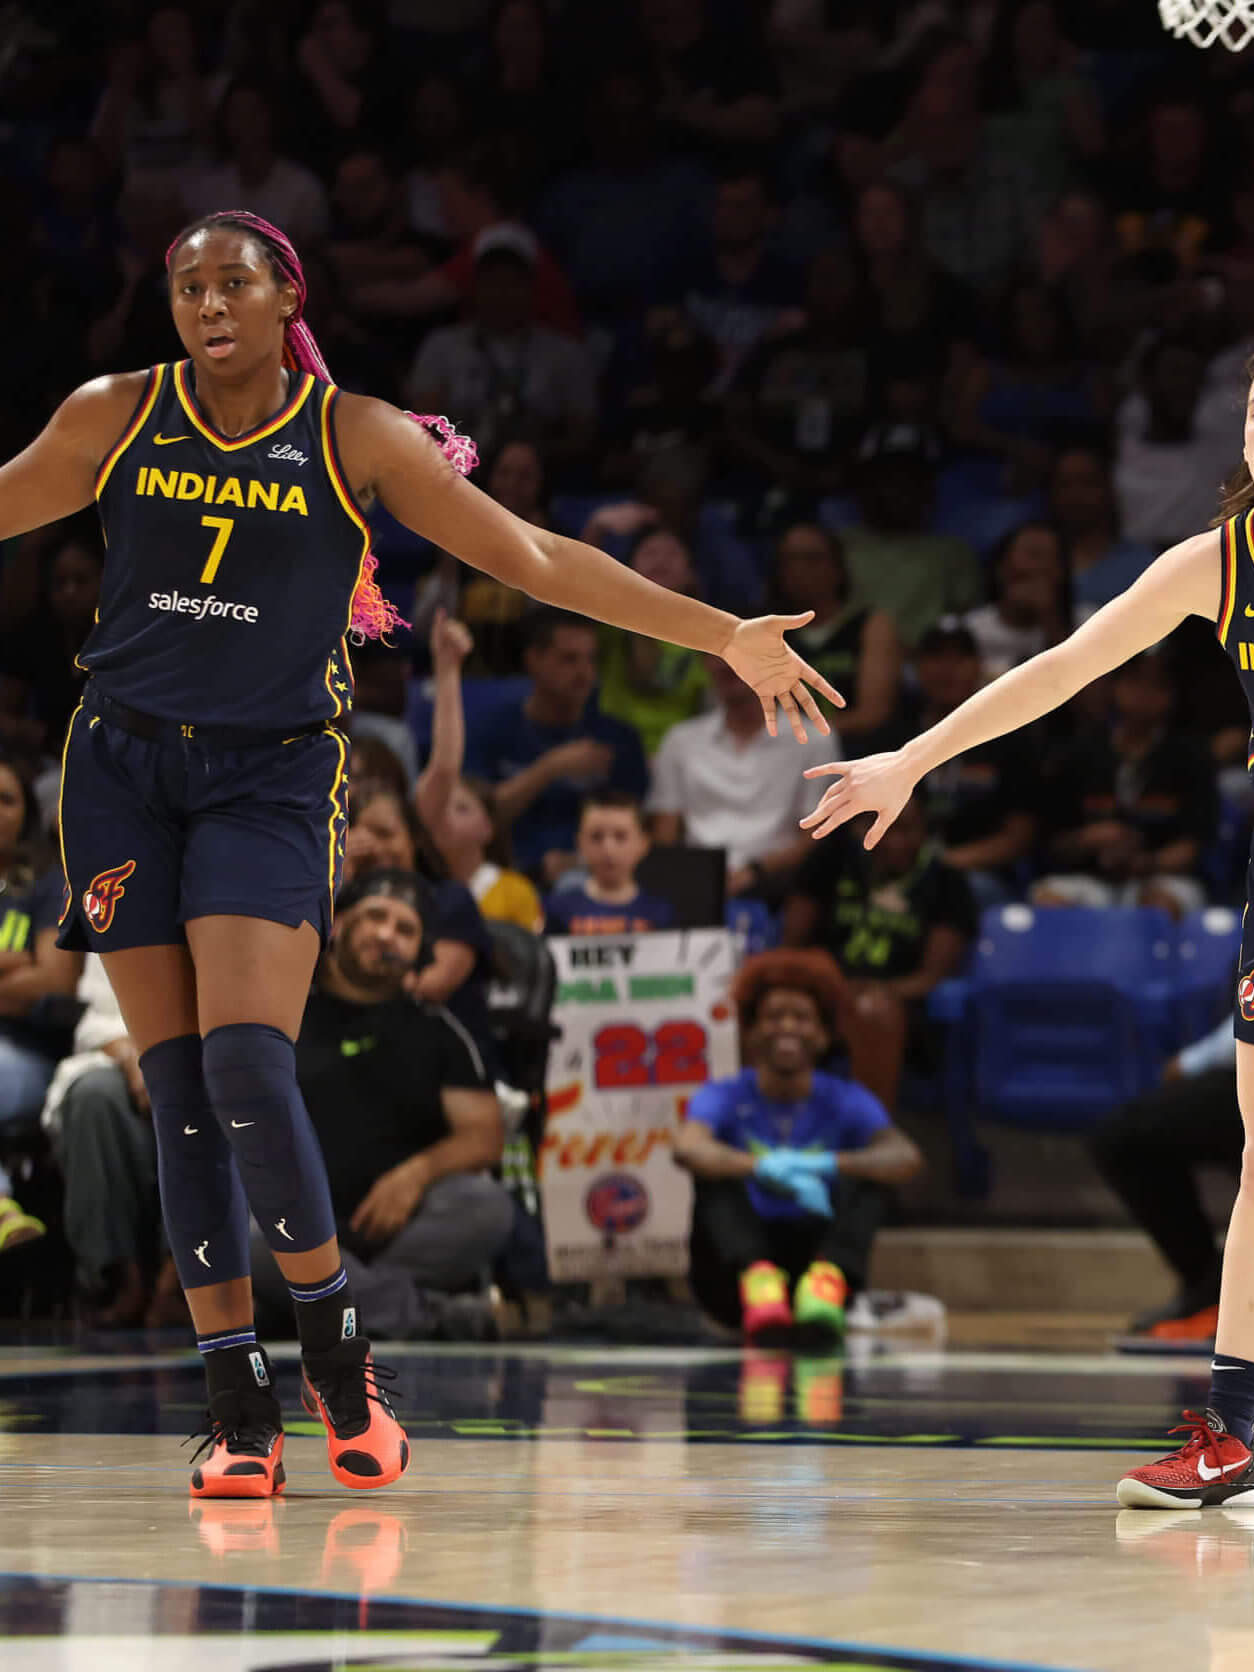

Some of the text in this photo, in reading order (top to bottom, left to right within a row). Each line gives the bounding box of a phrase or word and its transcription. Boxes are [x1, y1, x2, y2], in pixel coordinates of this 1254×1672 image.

[267, 443, 309, 467] Lilly
[135, 466, 309, 516] INDIANA
[200, 515, 235, 584] 7
[149, 590, 260, 623] salesforce
